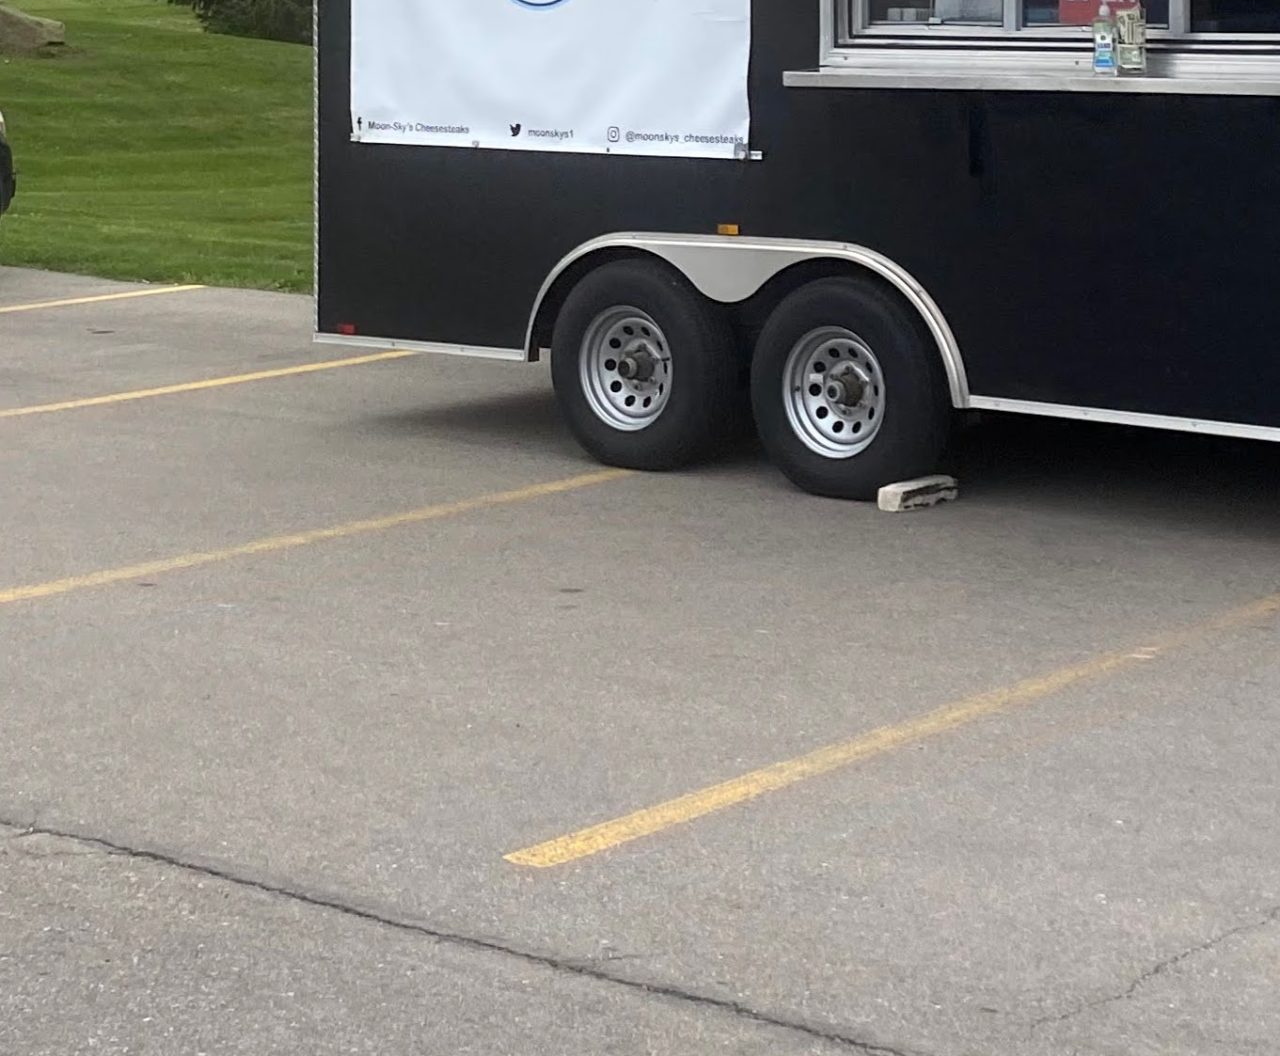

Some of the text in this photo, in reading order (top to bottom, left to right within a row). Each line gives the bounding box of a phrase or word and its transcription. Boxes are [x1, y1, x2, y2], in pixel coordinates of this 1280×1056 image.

[368, 120, 470, 134] Moon-Sky's Cheesesteaks
[528, 128, 574, 140] moonskys1
